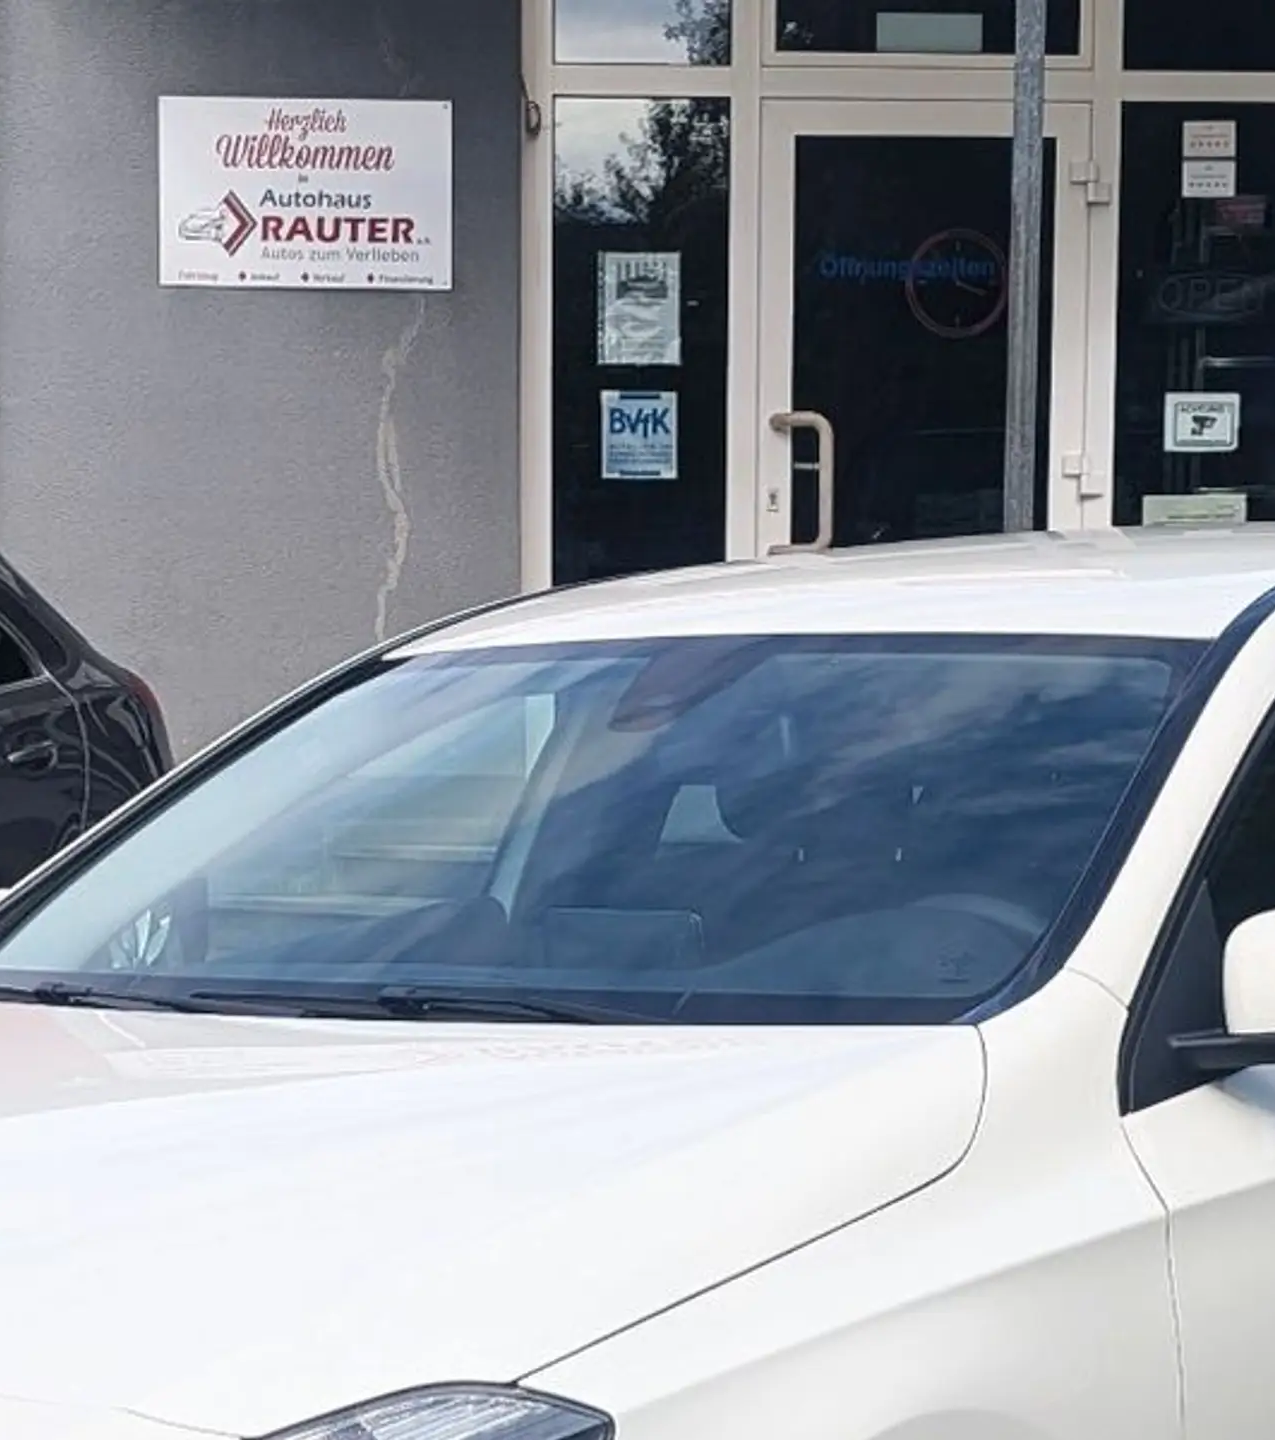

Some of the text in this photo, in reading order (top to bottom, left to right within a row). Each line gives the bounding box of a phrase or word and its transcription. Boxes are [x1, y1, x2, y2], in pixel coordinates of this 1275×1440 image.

[266, 107, 347, 141] Herzlich
[216, 133, 395, 171] Willkommen
[260, 189, 372, 209] Autohaus
[261, 215, 415, 244] RAUTER
[261, 247, 419, 263] Autos zum Verlieben
[610, 408, 671, 439] BVfK
